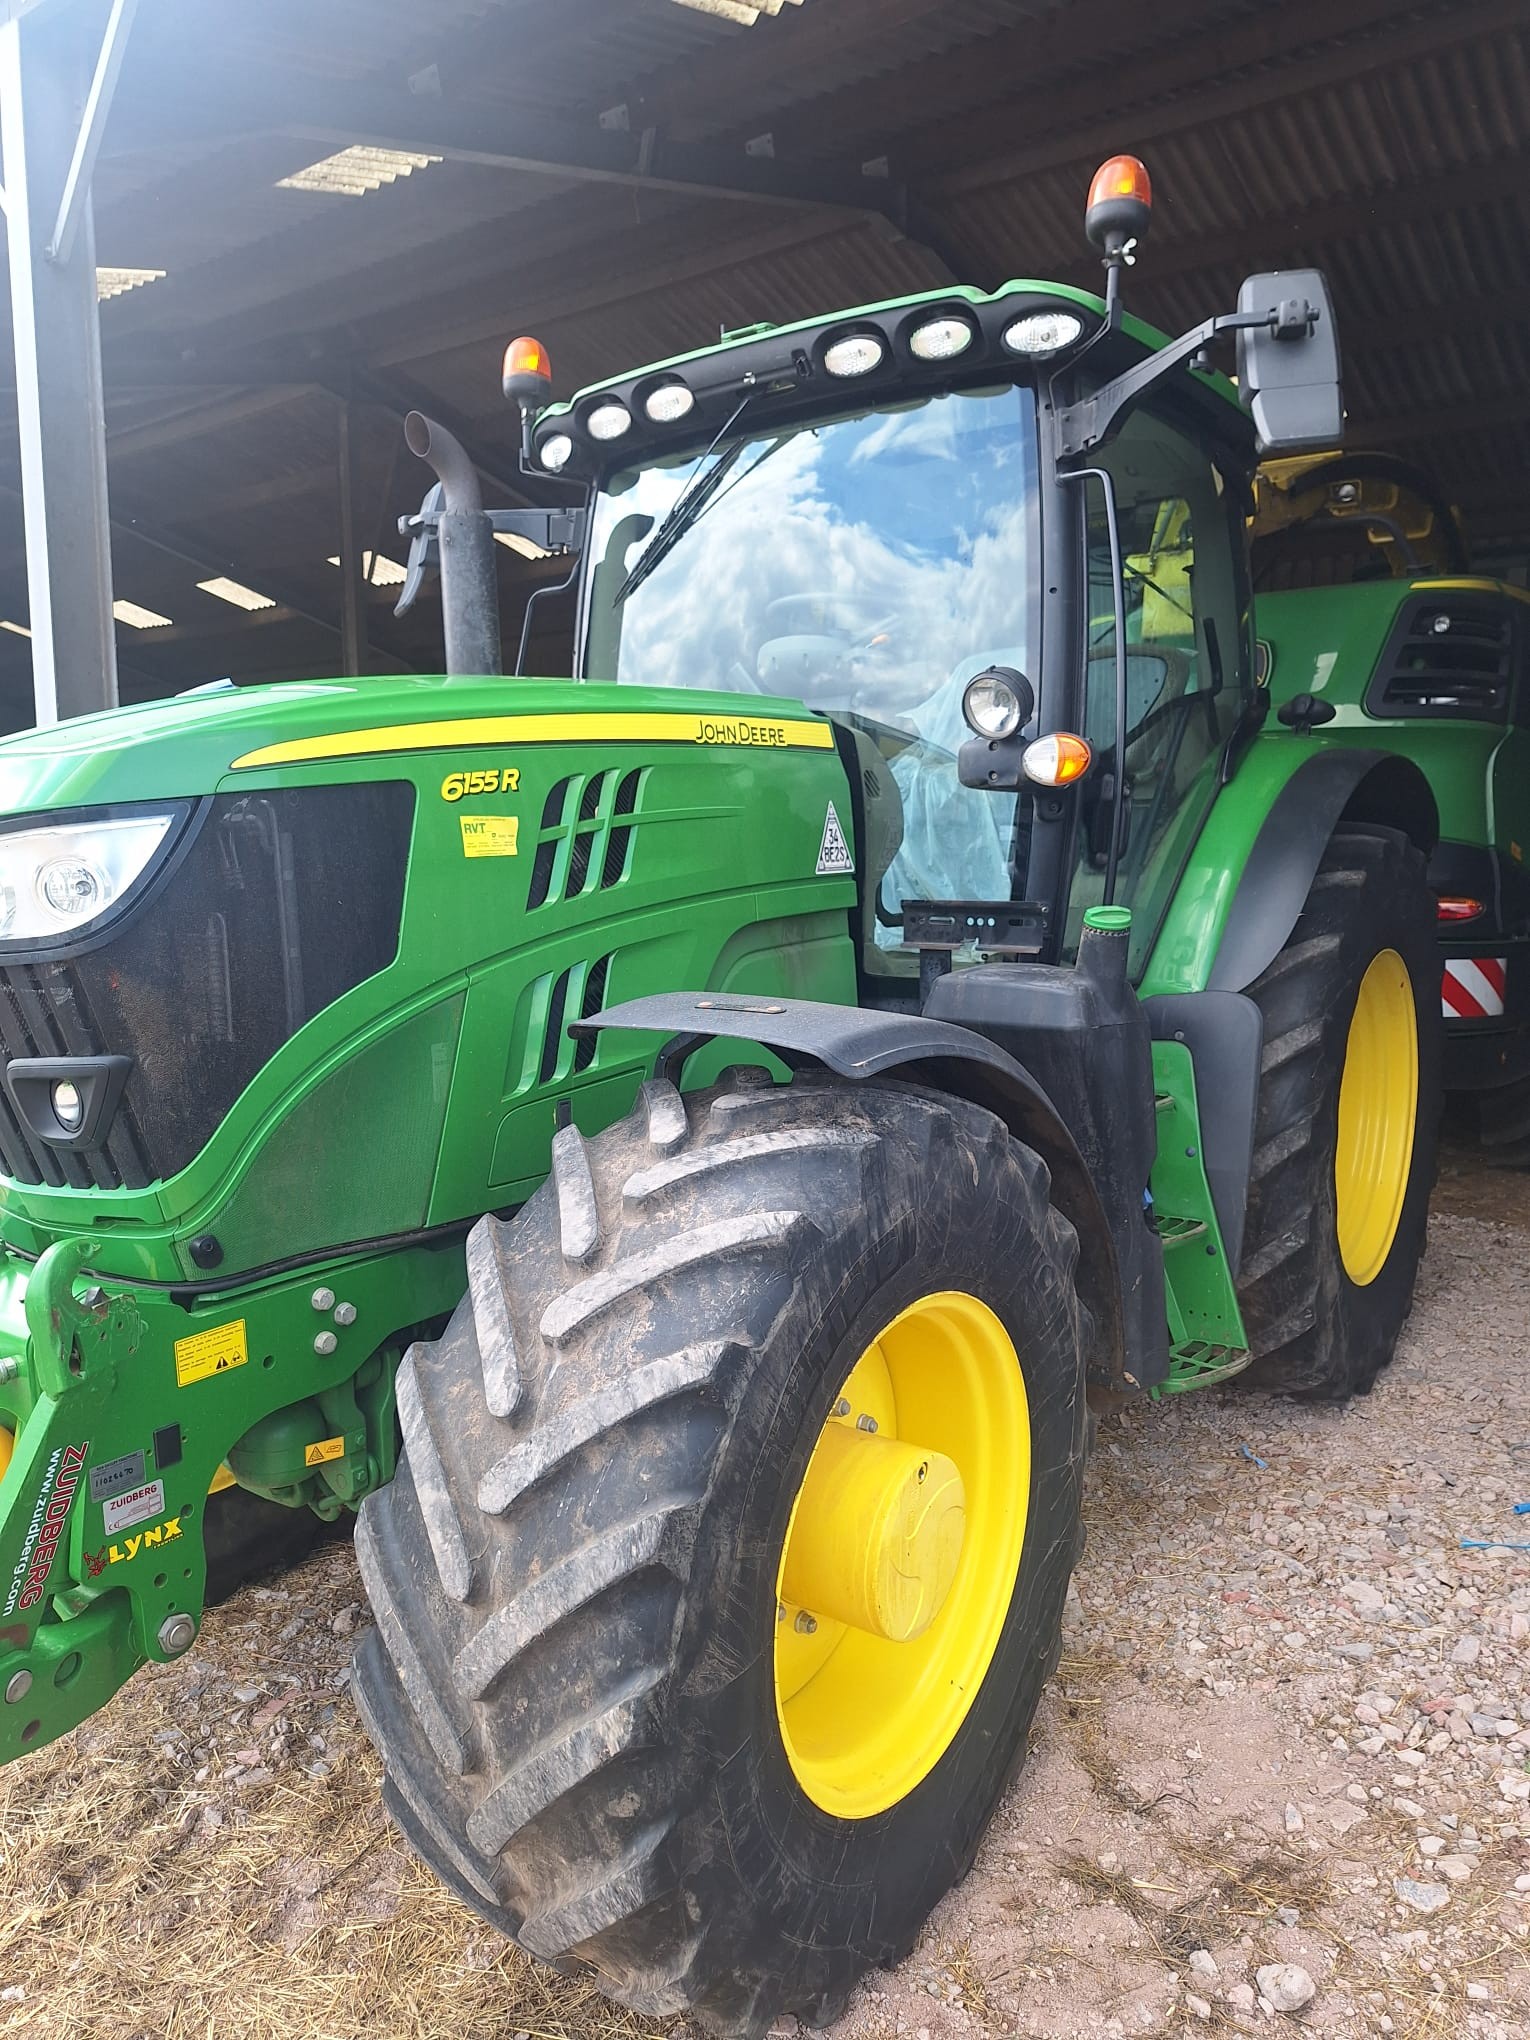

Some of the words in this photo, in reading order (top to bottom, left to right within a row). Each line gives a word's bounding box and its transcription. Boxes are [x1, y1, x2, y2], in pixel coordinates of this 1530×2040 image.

[696, 720, 737, 742] JOHN
[738, 722, 786, 744] DEERE
[463, 823, 486, 834] RVT
[828, 829, 839, 845] 34
[110, 1484, 158, 1511] ZUIDBERG
[3, 1448, 62, 1617] www.zuidberg.com
[19, 1441, 89, 1610] ZUIDBERG
[108, 1516, 183, 1565] LYNX
